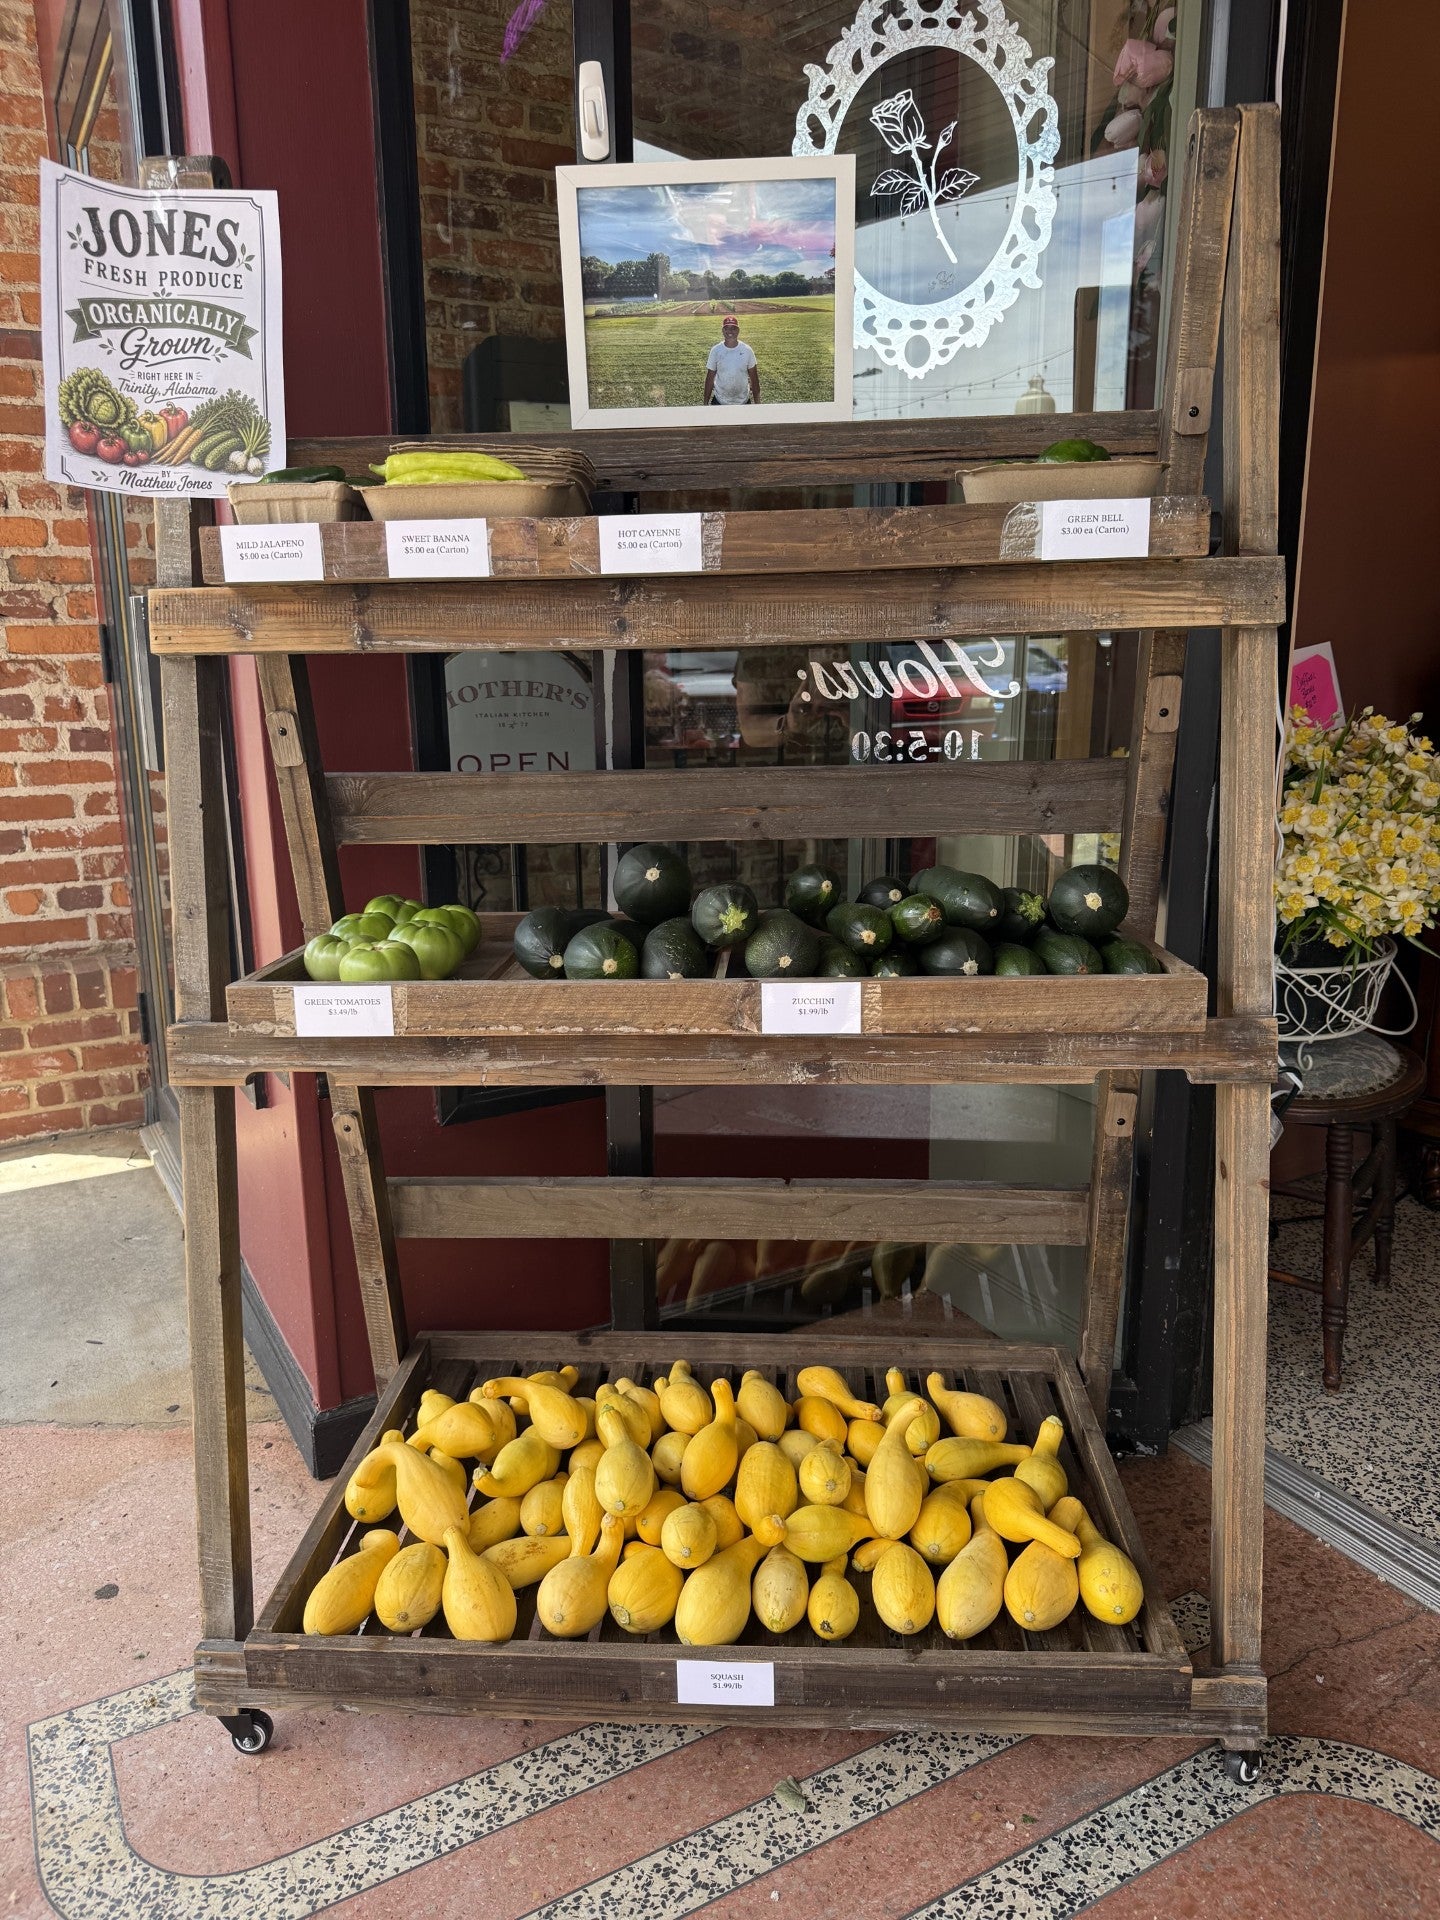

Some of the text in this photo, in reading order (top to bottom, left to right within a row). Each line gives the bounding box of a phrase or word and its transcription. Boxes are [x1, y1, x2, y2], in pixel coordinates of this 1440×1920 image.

[82, 207, 240, 268] JONES
[84, 258, 243, 289] FRESH PRODUCE
[89, 302, 239, 336] ORGANICALLY
[119, 326, 214, 370] Grown
[137, 371, 194, 381] RIGHT HERE IN
[118, 377, 218, 404] Trinity, Alabama
[161, 470, 172, 478] BY
[118, 470, 213, 492] Matthew Jones
[1067, 514, 1124, 523] GREEN BELL
[618, 529, 681, 538] HOT CAYENNE
[1061, 524, 1130, 535] $3.00 ea (Carton)
[402, 534, 470, 543] SWEET BANANA
[236, 540, 305, 550] MILD JALAPENO
[617, 540, 682, 549] $5.00 ea (Carton)
[404, 546, 425, 554] $5.00
[436, 545, 469, 554] (Carton)
[239, 552, 260, 560] $5.00
[271, 551, 303, 560] (Carton)
[304, 998, 381, 1006] GREEN TOMATOES
[792, 997, 835, 1005] ZUCCHINI
[328, 1007, 358, 1016] $3.49/lb
[798, 1008, 829, 1016] $1.99/lb
[710, 1673, 745, 1681] SQUASH
[712, 1682, 743, 1690] $1.99/lb
